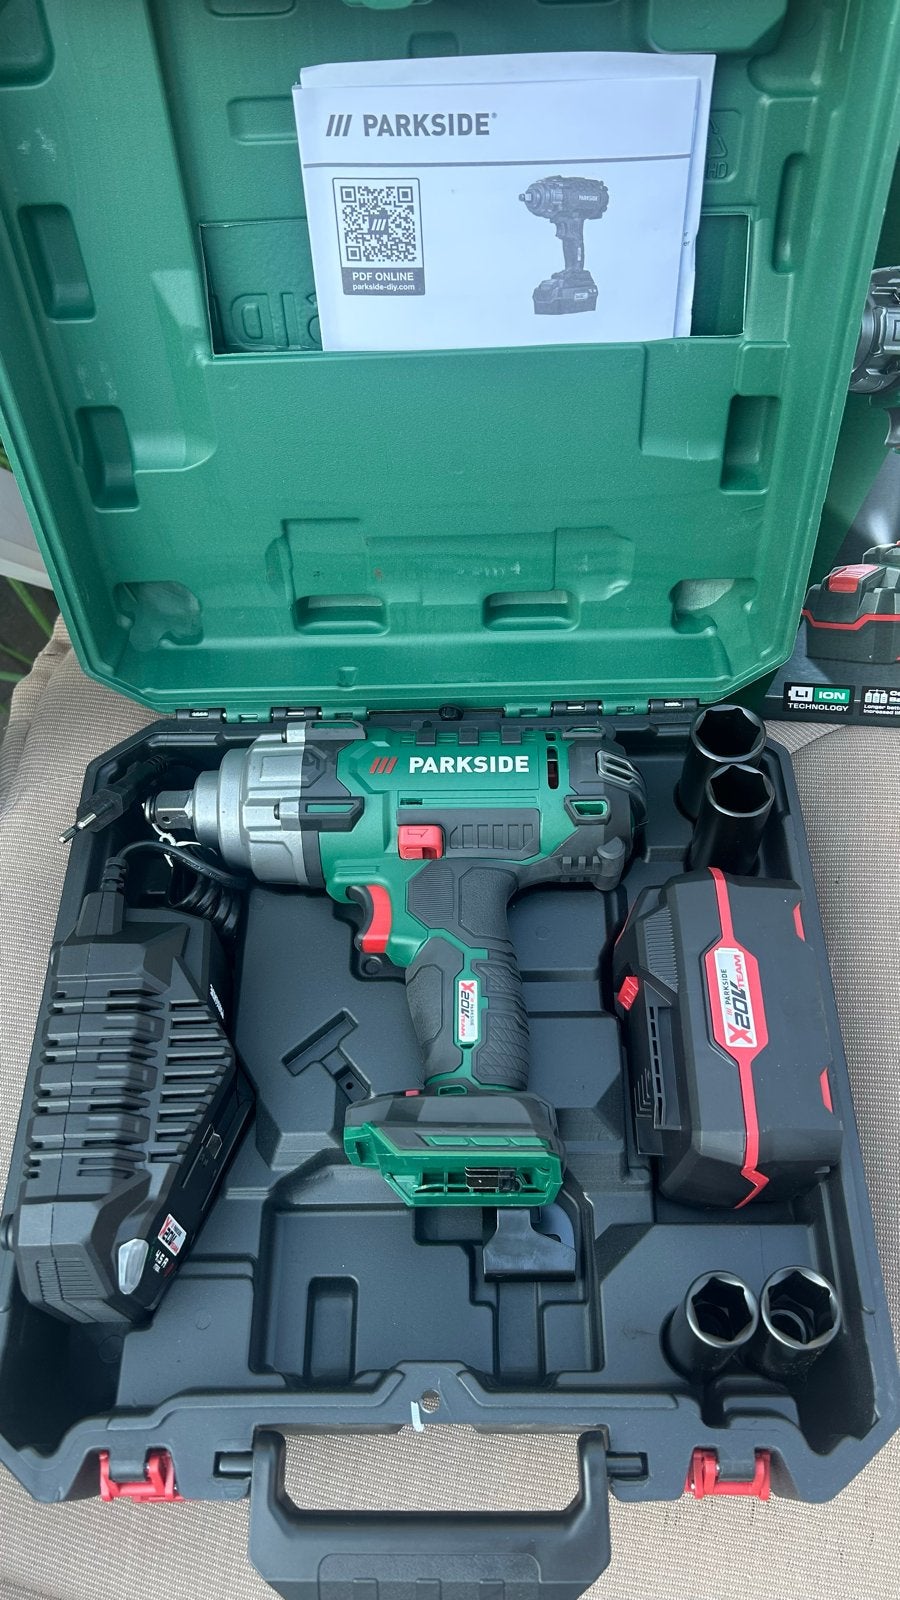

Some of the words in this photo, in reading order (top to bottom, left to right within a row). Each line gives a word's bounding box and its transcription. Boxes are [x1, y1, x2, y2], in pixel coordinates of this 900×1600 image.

[352, 271, 373, 281] PDF
[374, 271, 414, 281] ONLINE
[352, 283, 415, 292] parkside-diy.com
[795, 690, 808, 698] LI
[818, 691, 846, 700] ION
[788, 702, 849, 712] TECHNOLOGY
[409, 755, 530, 774] PARKSIDE
[733, 954, 745, 988] TEAM
[720, 968, 732, 1005] PARKSIDE
